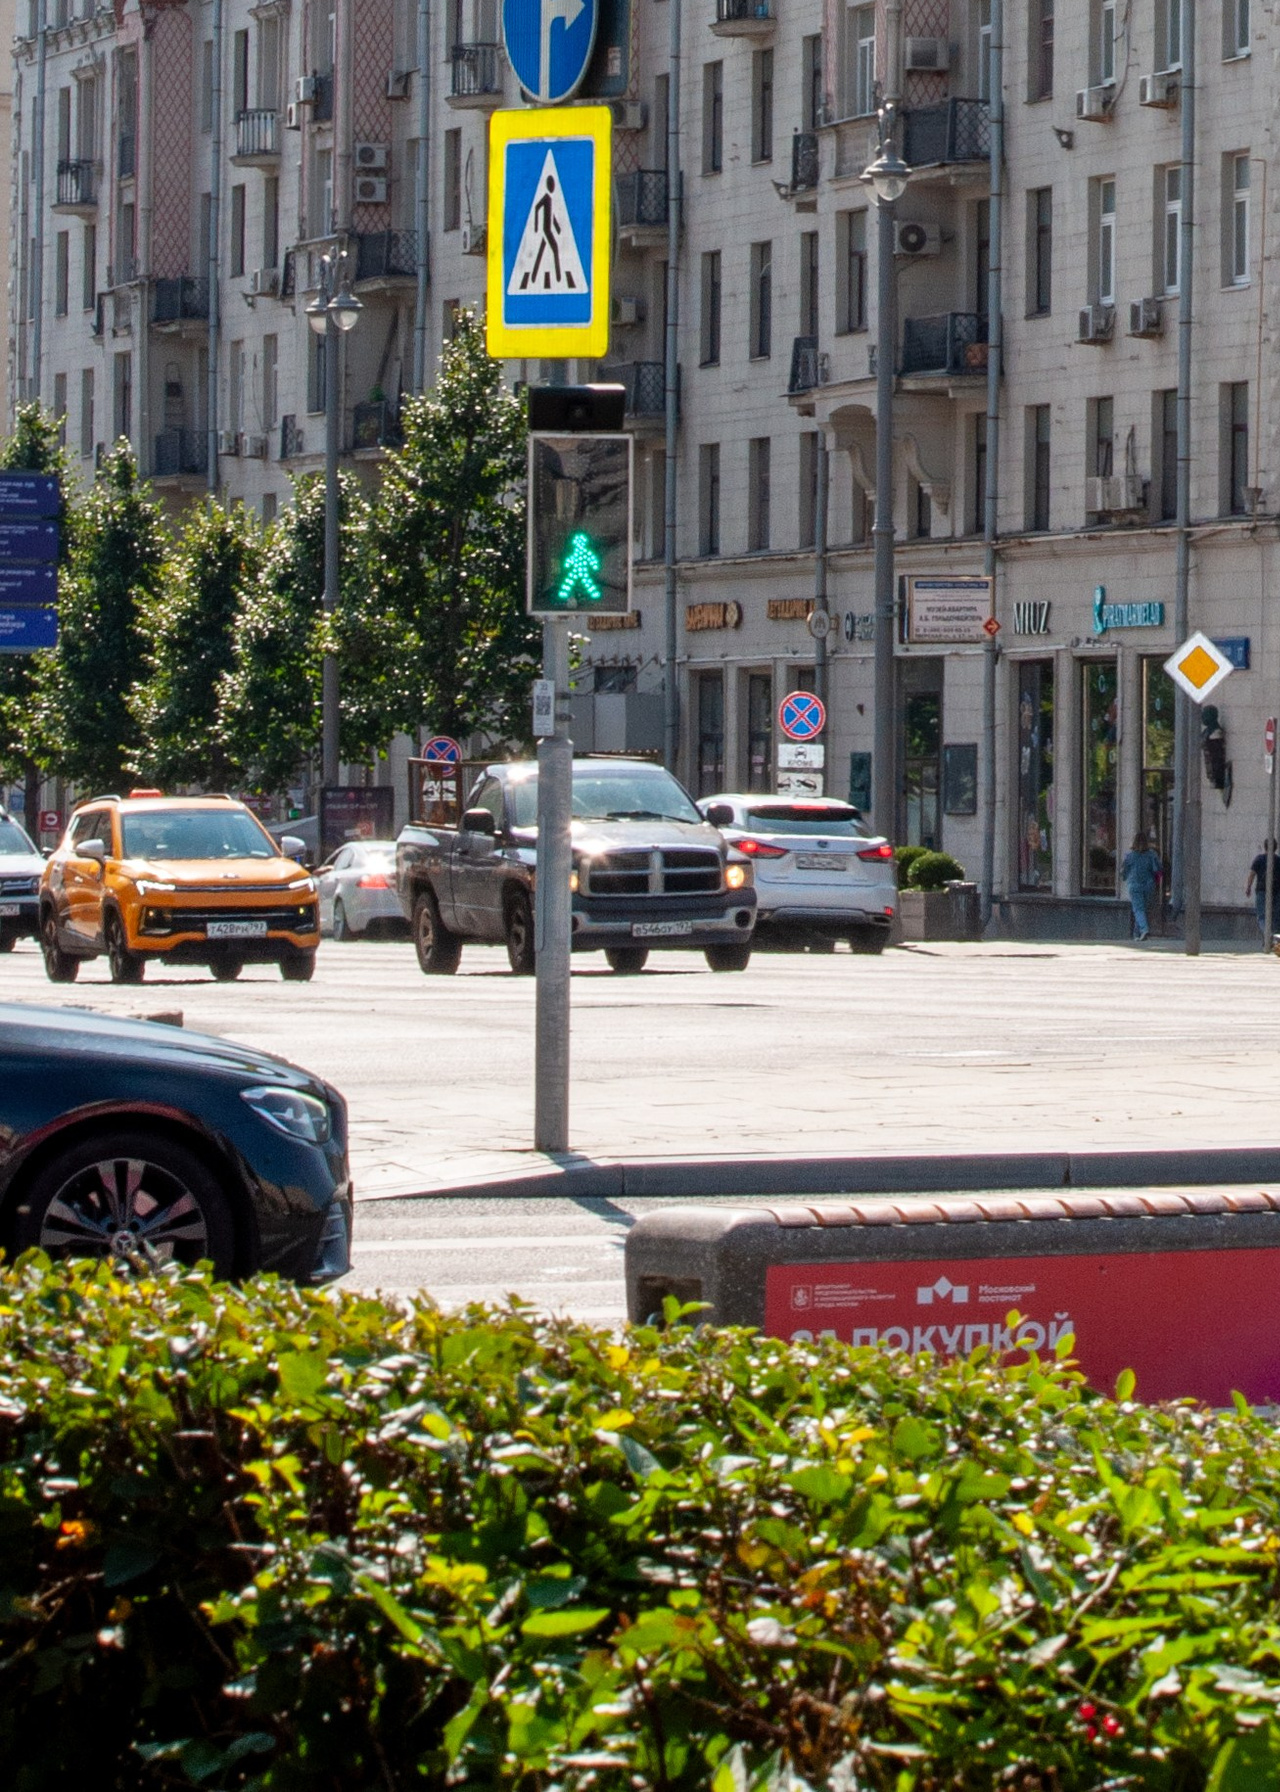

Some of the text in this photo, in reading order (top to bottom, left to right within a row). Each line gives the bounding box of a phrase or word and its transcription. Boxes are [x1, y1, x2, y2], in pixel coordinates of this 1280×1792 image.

[1013, 600, 1050, 634] MIUZ
[978, 1284, 1036, 1295] Московский
[978, 1293, 1022, 1303] постамат
[852, 1312, 1075, 1355] ПОКУПКОЙ
